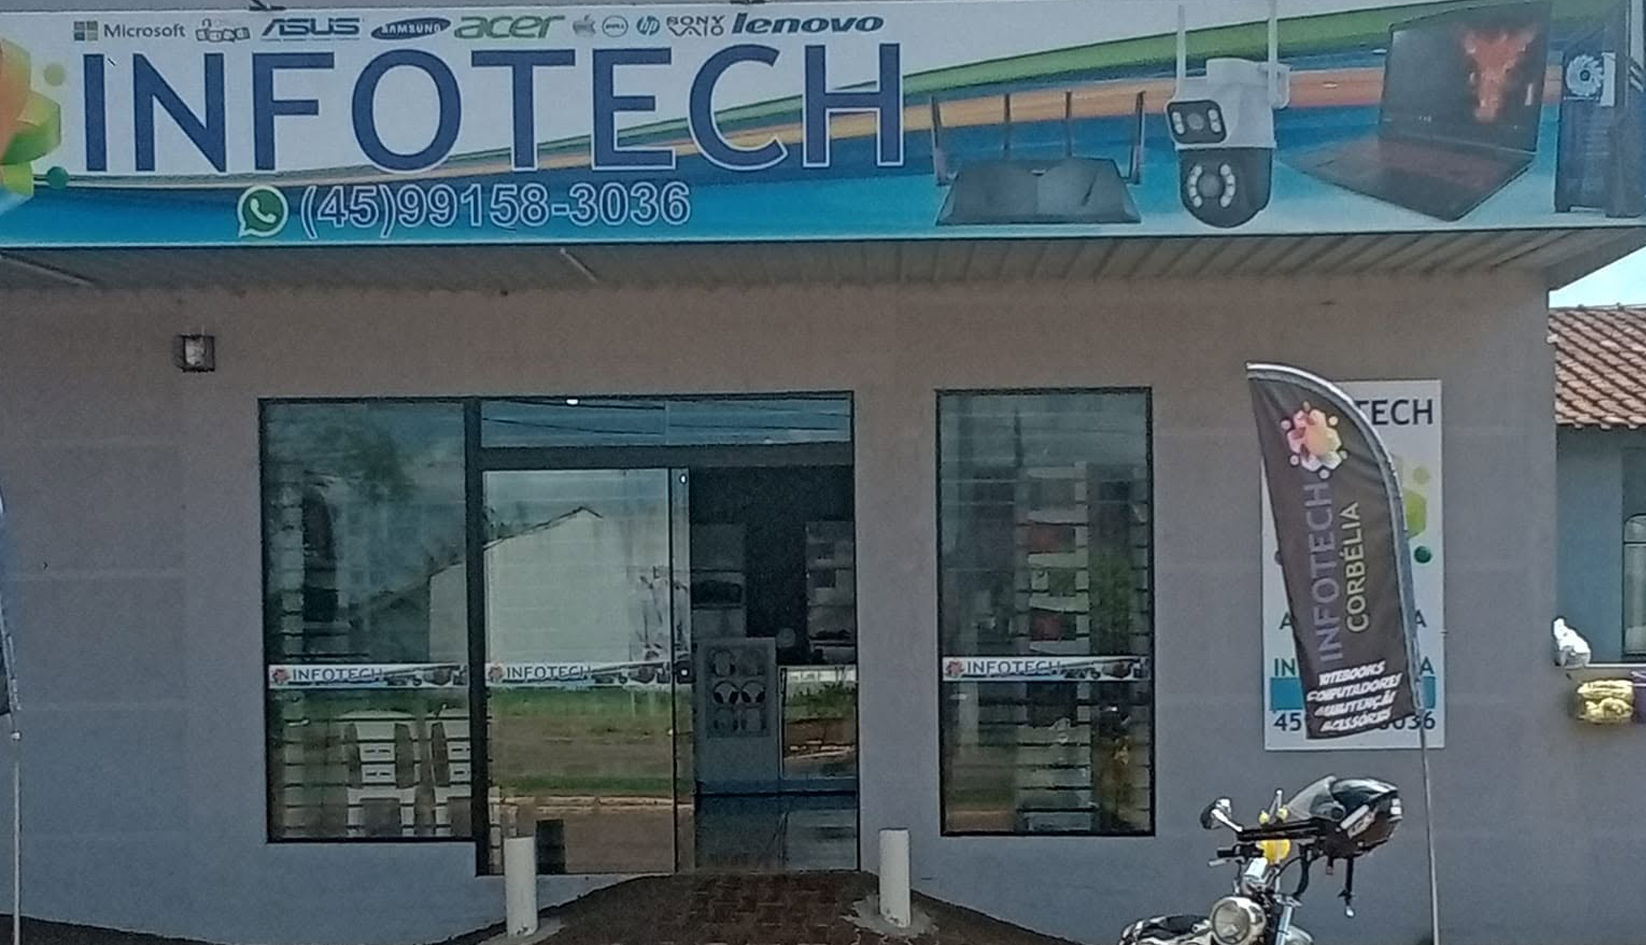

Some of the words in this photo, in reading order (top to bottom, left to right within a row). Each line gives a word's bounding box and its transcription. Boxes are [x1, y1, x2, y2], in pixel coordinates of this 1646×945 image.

[103, 22, 186, 39] Microsoft
[261, 17, 361, 37] ASUS
[454, 15, 566, 39] acer
[637, 15, 660, 36] hp
[666, 14, 725, 26] SONY
[731, 13, 885, 35] lenovo
[668, 25, 725, 37] VAIO
[82, 42, 905, 174] INFOTECH
[299, 182, 691, 239] (45)99158-3036
[1353, 398, 1434, 426] TECH
[1303, 481, 1344, 662] INFOTECH
[1339, 501, 1370, 633] CORBÉLIA
[292, 667, 384, 683] INFOTECH
[506, 665, 594, 680] INFOTECH
[966, 660, 1062, 675] INFOTECH
